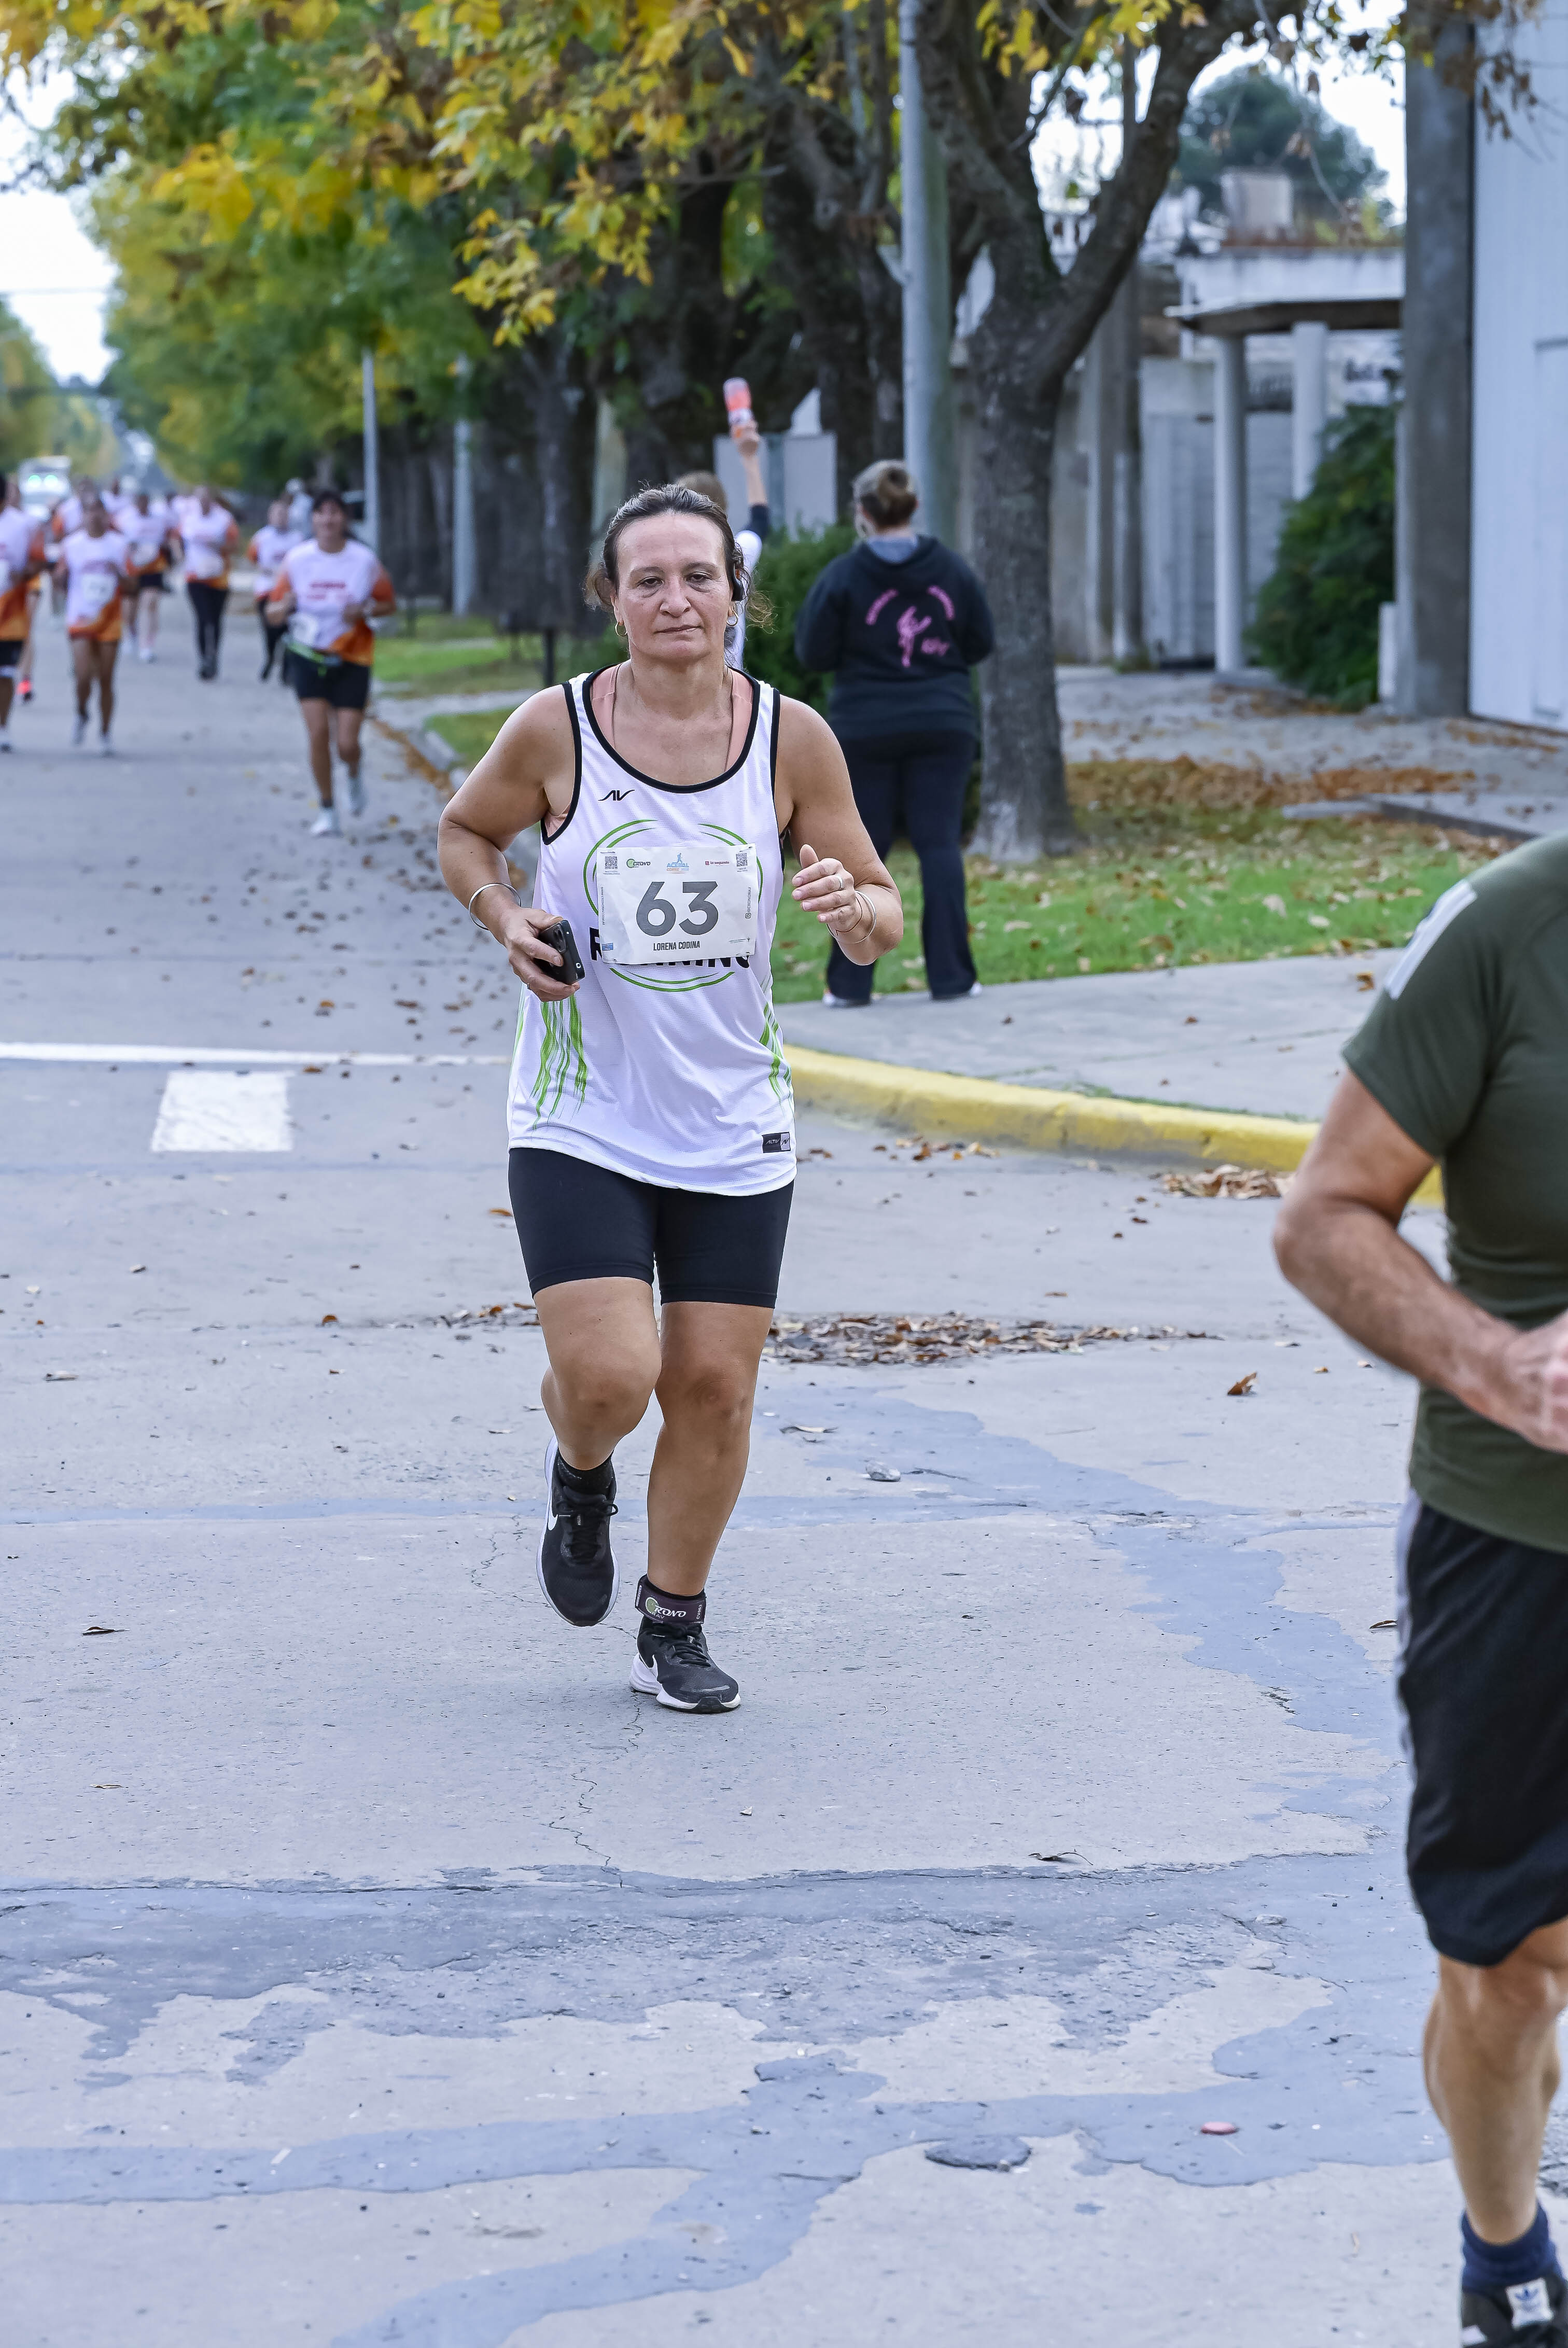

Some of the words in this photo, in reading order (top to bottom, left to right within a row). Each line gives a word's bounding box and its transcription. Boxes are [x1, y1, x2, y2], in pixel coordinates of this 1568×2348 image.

[636, 881, 718, 936] 63
[653, 942, 677, 951] LORENA
[678, 941, 700, 949] CODINA
